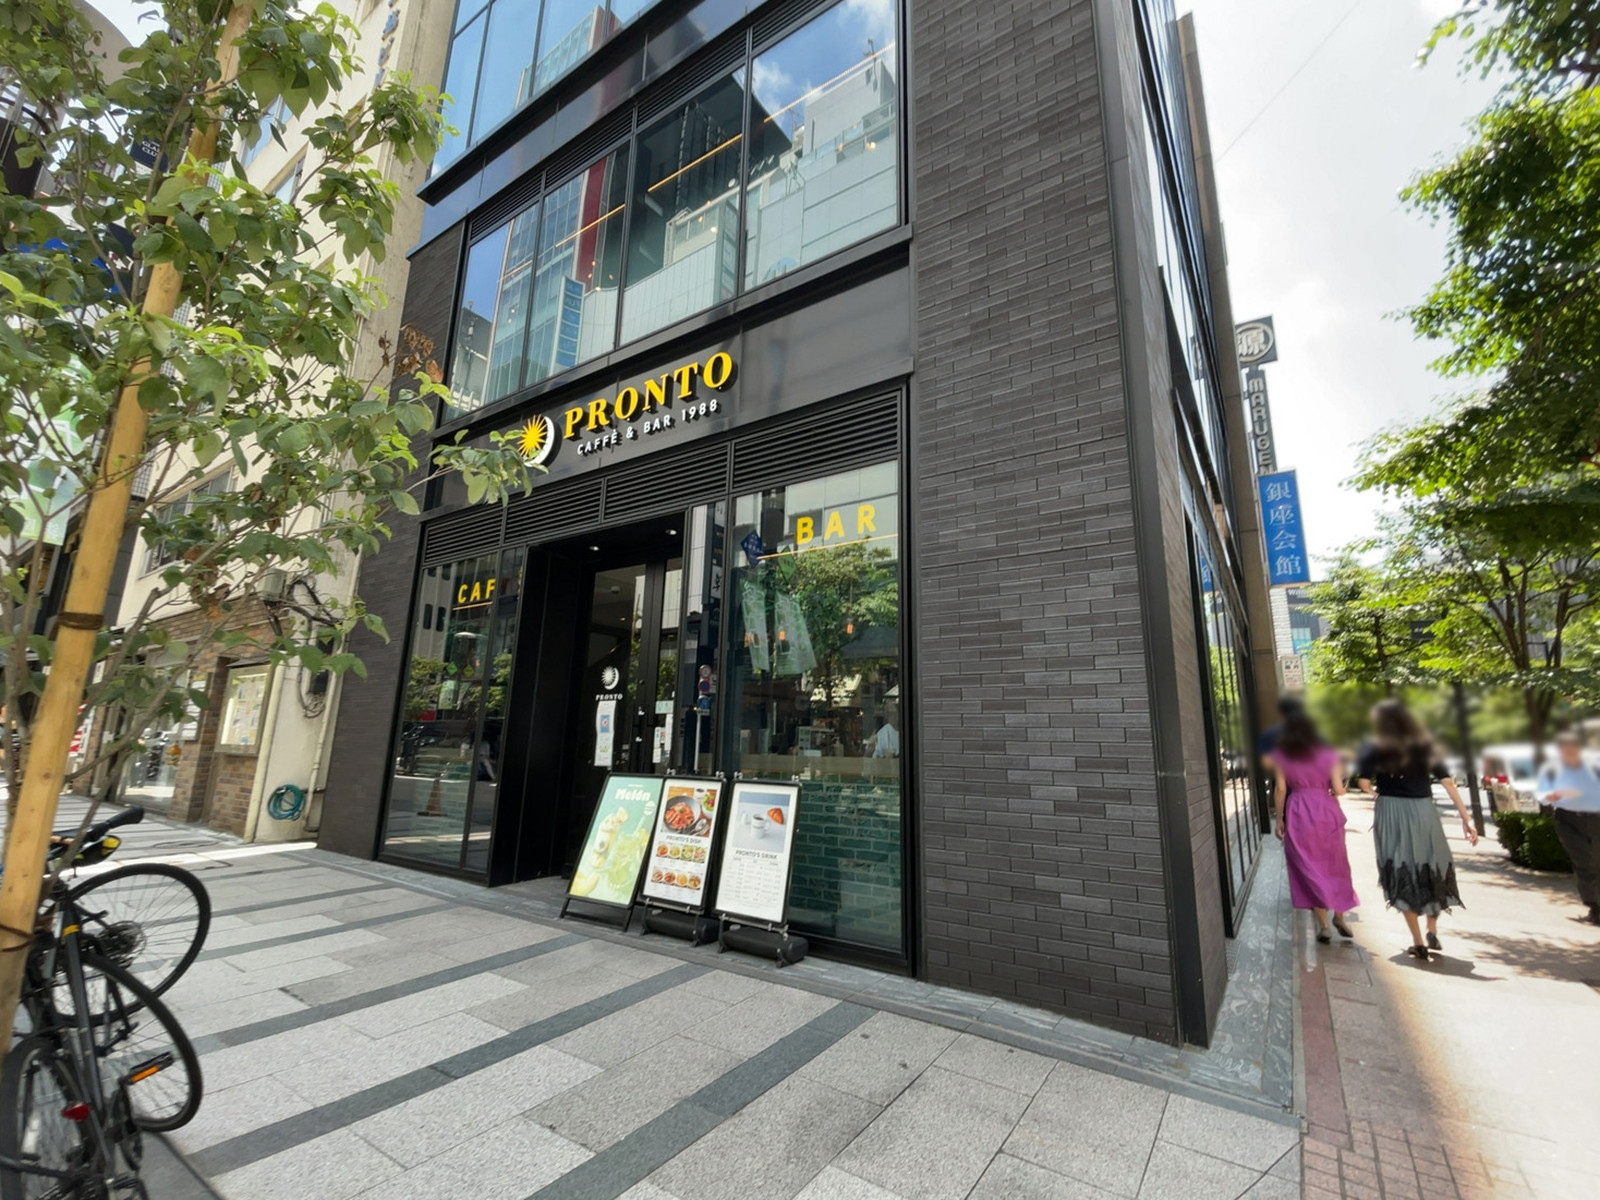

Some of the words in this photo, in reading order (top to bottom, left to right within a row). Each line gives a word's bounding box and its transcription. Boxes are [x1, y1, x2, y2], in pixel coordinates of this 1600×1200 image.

[564, 352, 733, 439] PRONTO
[577, 428, 619, 455] CAFFÈ
[626, 426, 634, 439] &
[643, 414, 671, 433] BAR
[681, 399, 718, 421] 1988
[796, 504, 877, 545] BAR
[1265, 481, 1302, 577] 銀座会館
[595, 693, 623, 701] PRONTO
